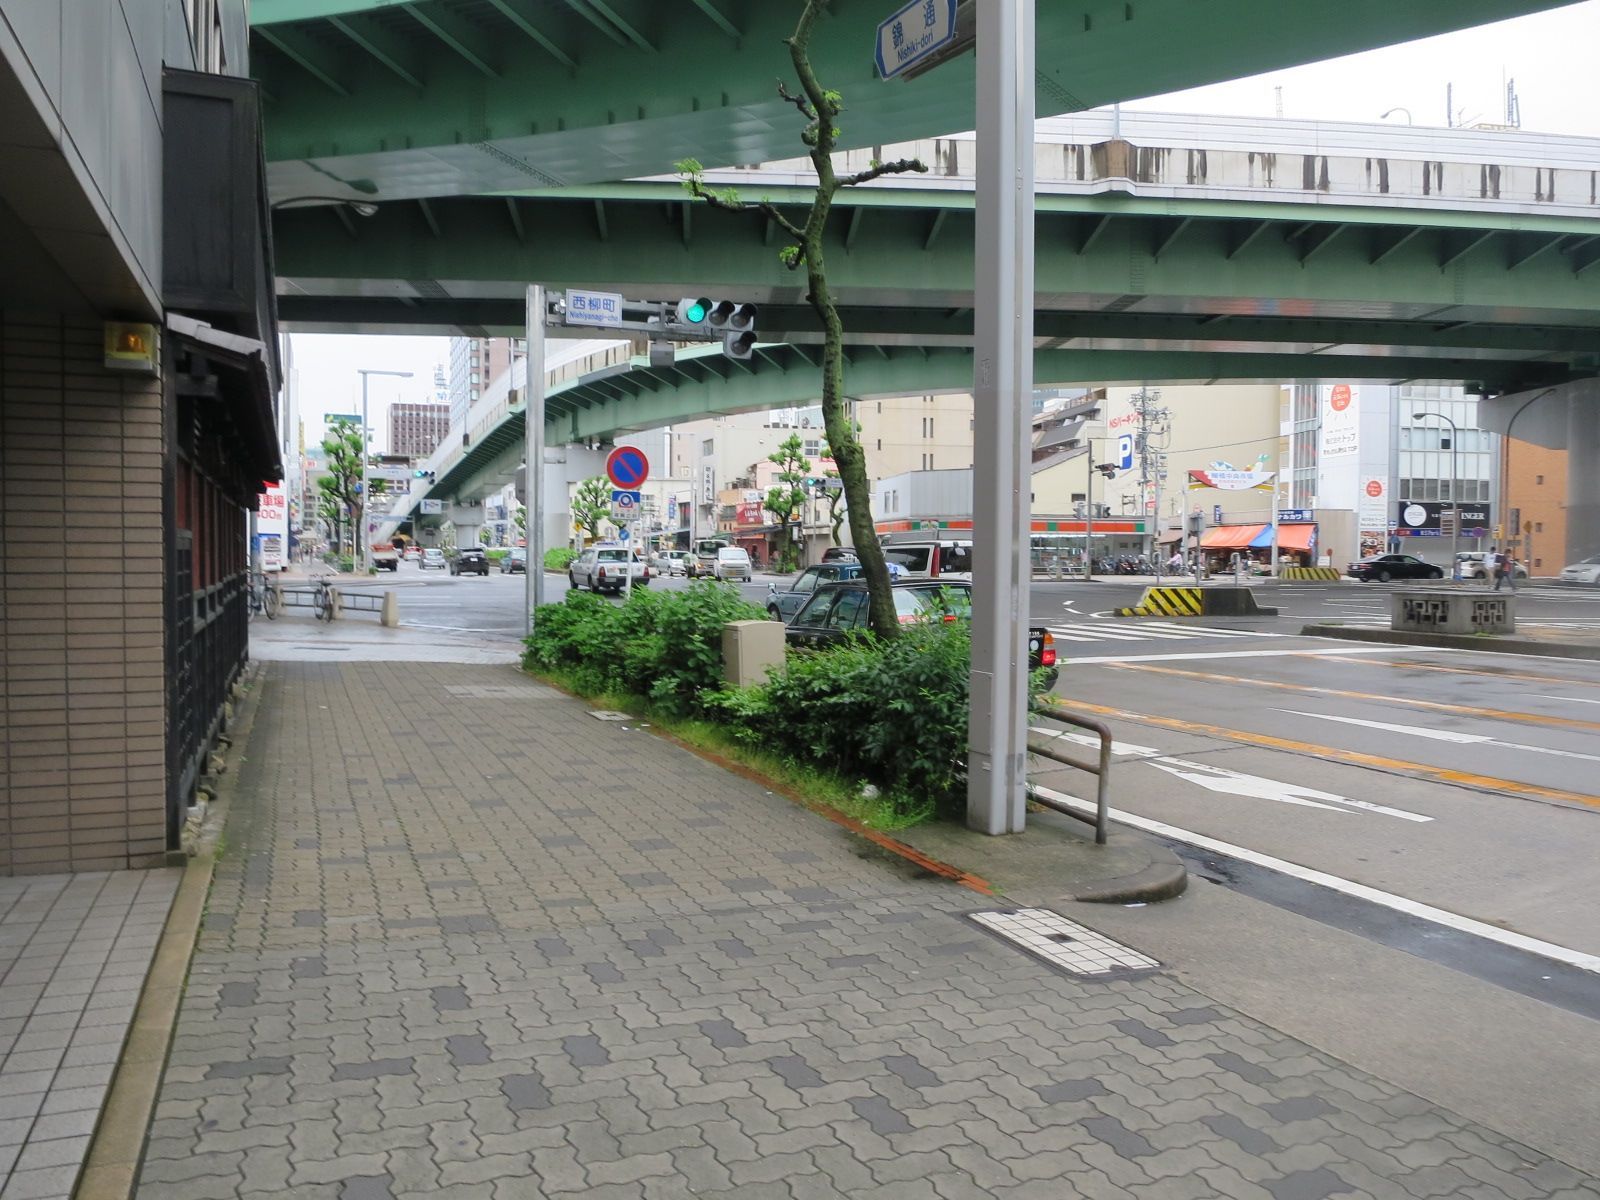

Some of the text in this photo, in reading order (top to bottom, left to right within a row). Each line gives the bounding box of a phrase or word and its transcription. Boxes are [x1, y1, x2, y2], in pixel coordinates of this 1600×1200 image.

[897, 29, 934, 63] Nishiki-dori
[572, 295, 616, 313] 西柳町
